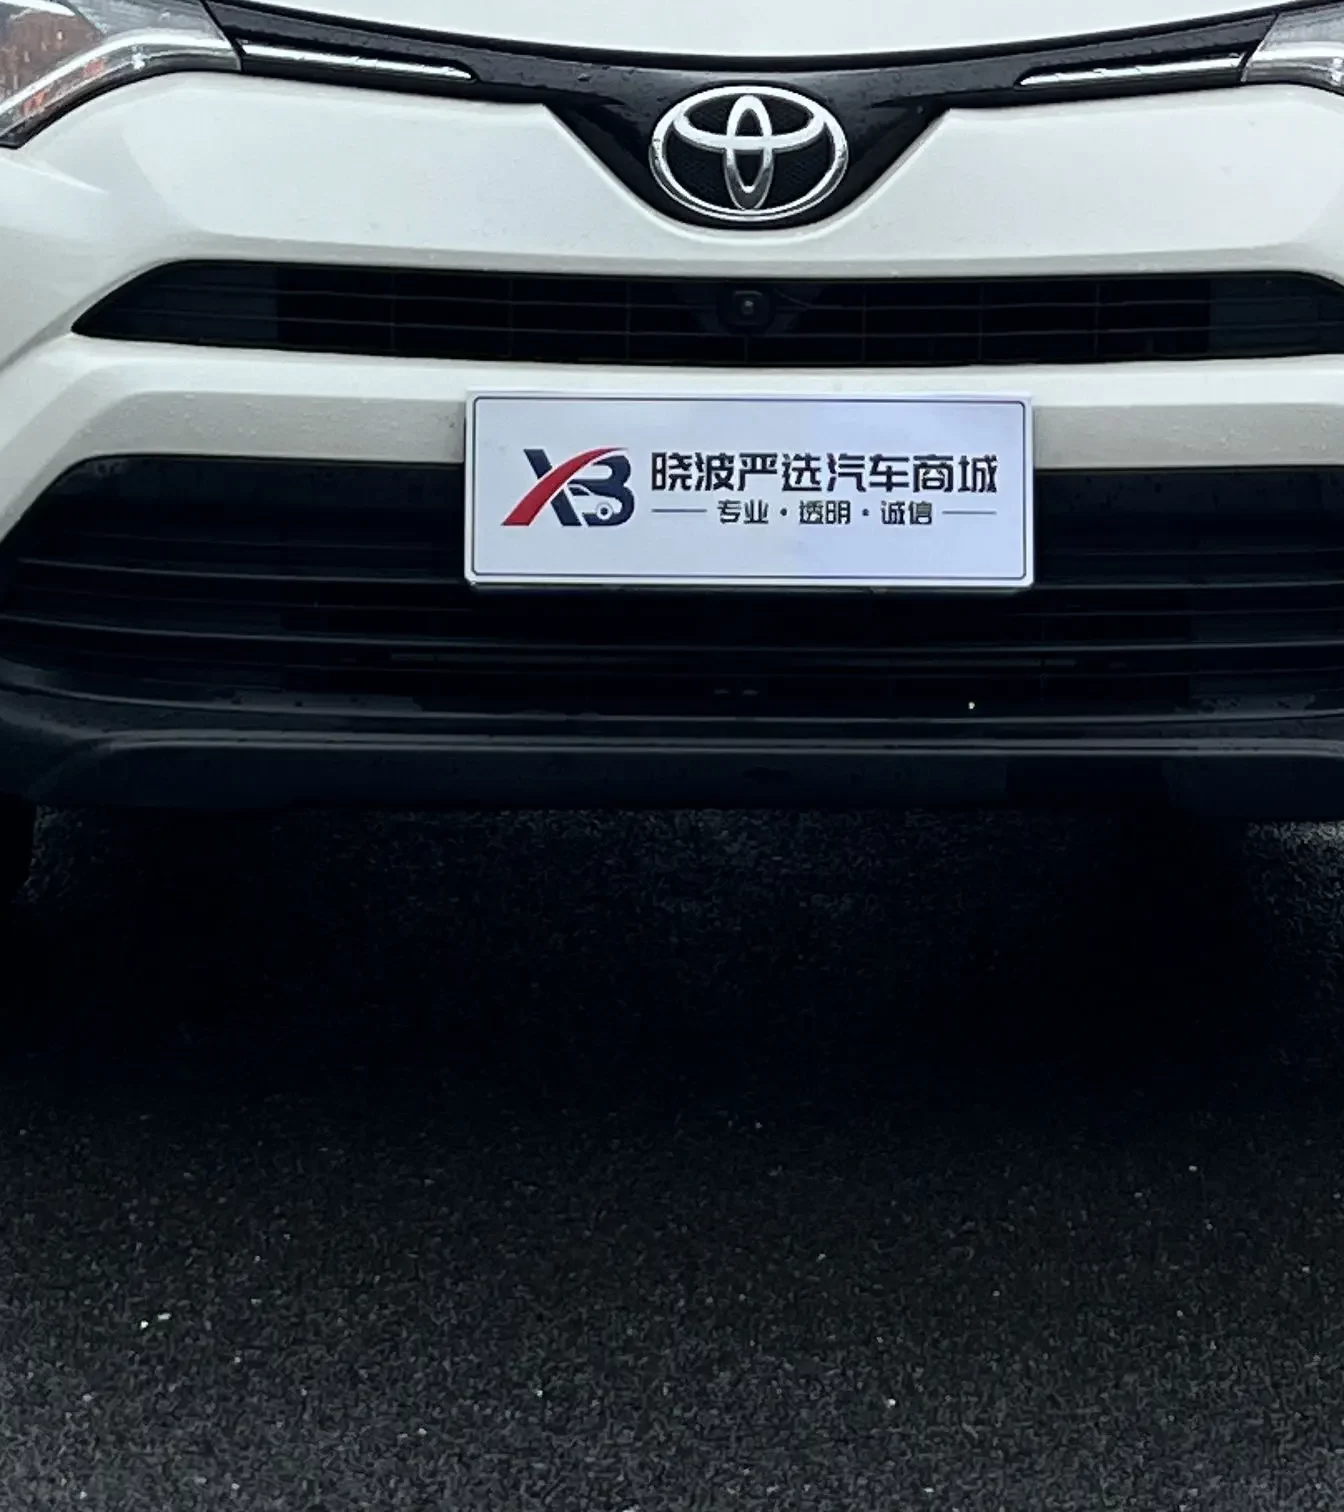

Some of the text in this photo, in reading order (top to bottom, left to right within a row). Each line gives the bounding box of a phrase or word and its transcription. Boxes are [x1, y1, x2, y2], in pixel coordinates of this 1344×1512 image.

[651, 452, 998, 493] 晓波严选汽车商城
